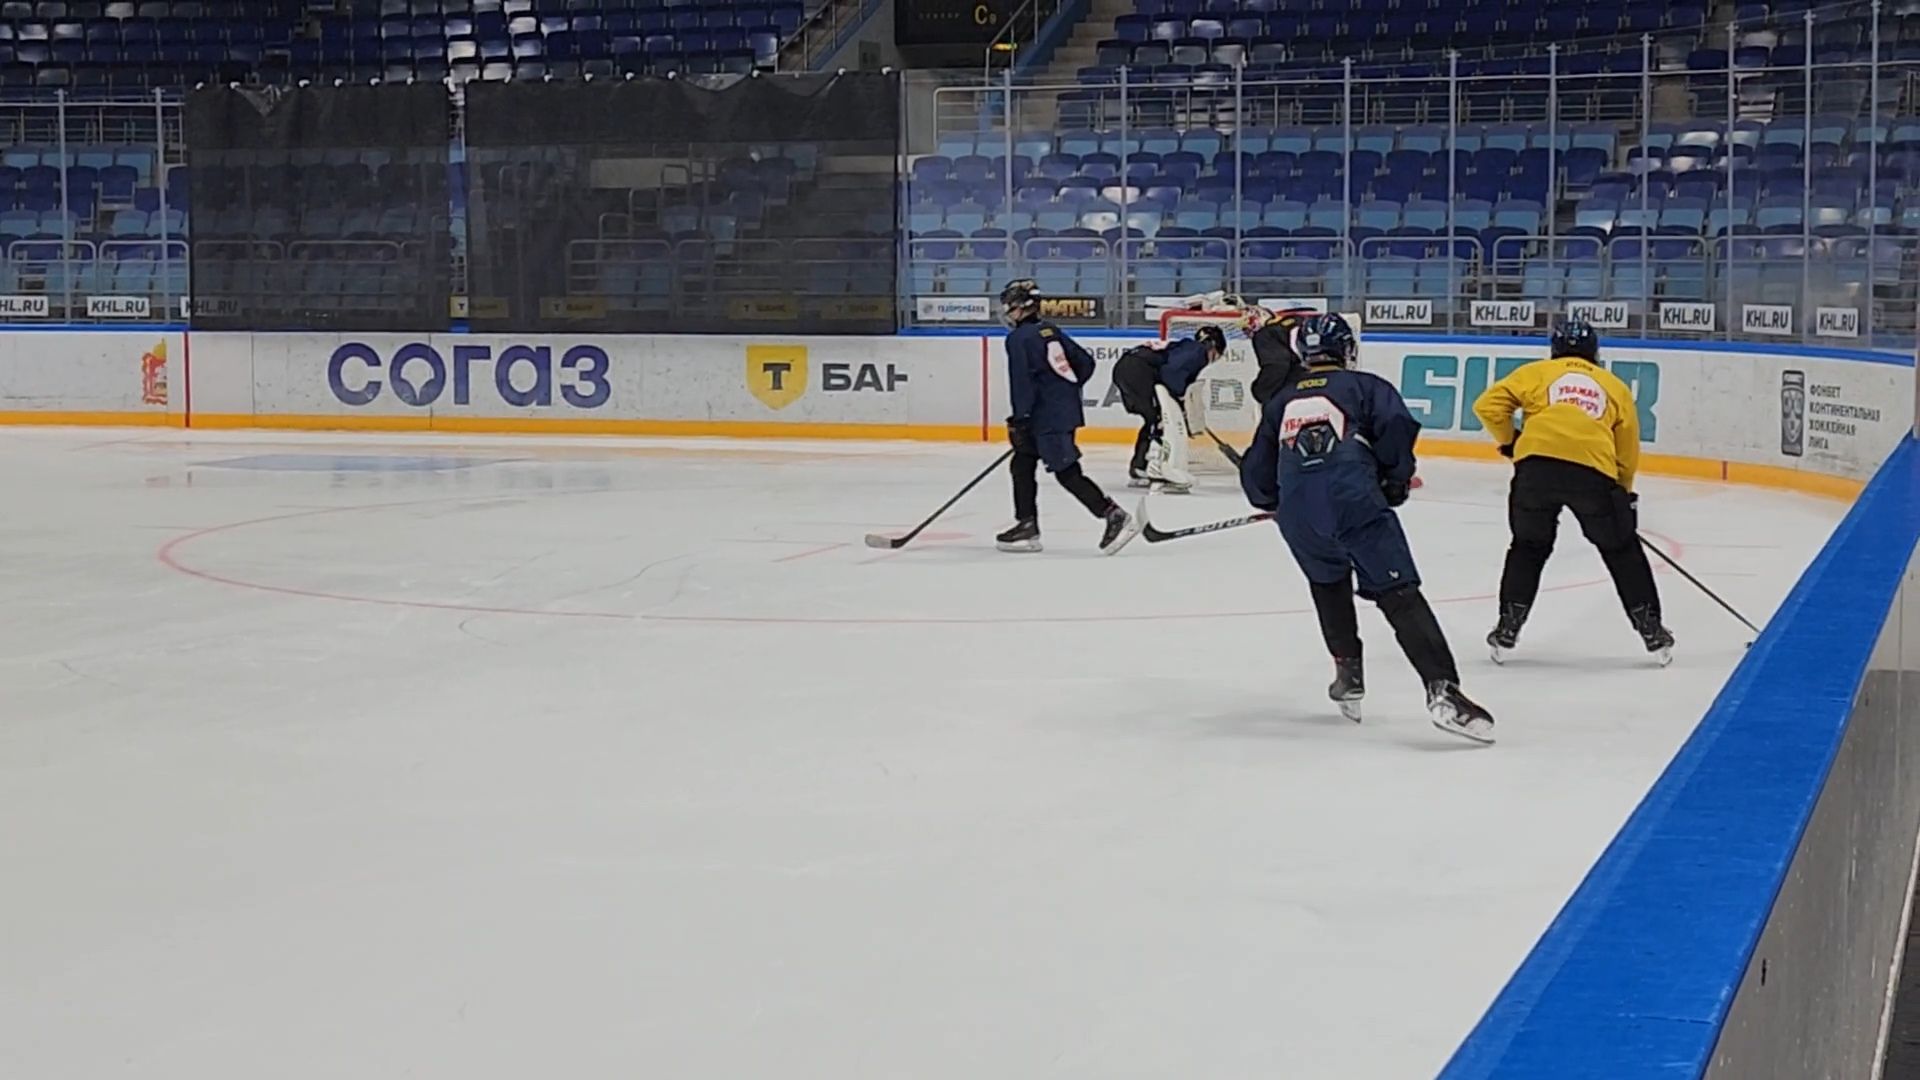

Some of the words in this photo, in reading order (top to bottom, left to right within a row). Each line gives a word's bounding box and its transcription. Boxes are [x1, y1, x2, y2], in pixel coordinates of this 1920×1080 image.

[0, 299, 44, 312] HL.RU
[91, 300, 145, 313] KHL.RU
[1040, 299, 1096, 317] МАТЧ!
[1370, 304, 1427, 320] KHL.RU
[1475, 305, 1530, 322] KHL.RU
[1572, 307, 1624, 323] KHL.RU
[1663, 307, 1711, 325] KHL.RU
[1746, 310, 1788, 329] KHL.RU
[1819, 312, 1855, 330] KHL.RU
[1400, 355, 1659, 442] SIR
